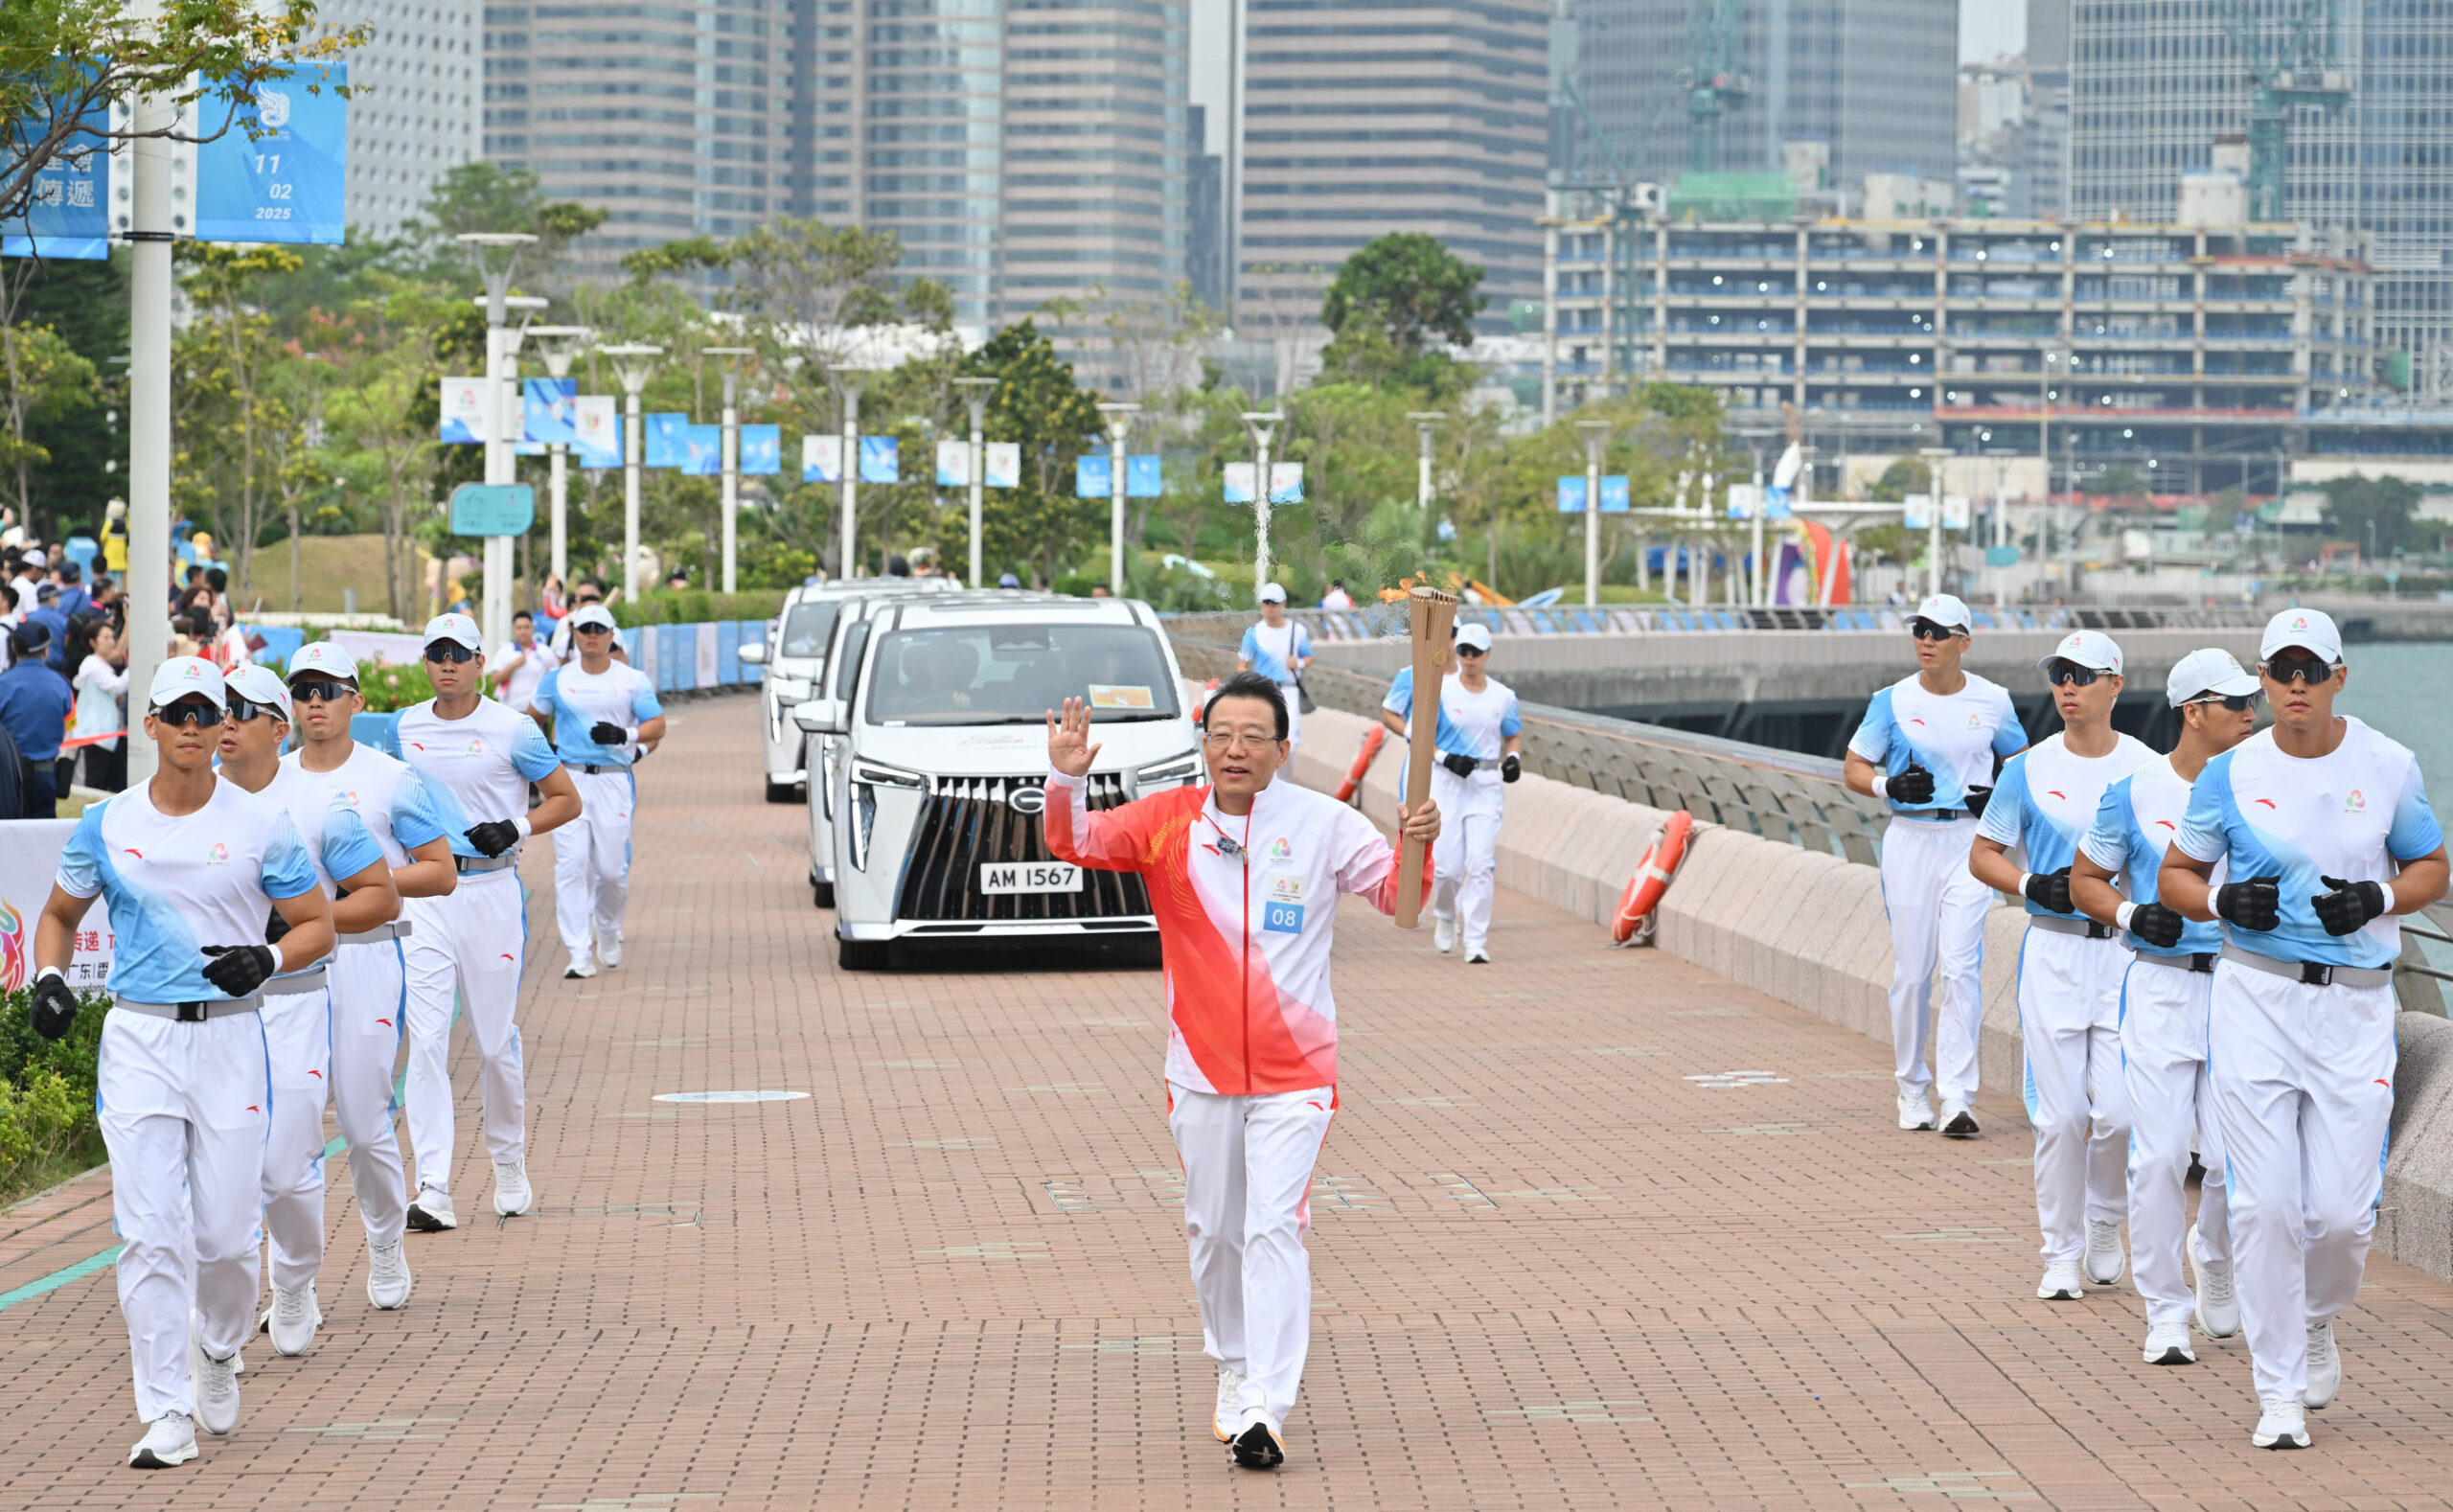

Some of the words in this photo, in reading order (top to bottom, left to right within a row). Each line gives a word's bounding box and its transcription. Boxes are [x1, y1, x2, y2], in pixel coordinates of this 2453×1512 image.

[255, 154, 280, 173] 11
[269, 183, 292, 199] 02
[255, 207, 291, 219] 2025
[989, 870, 1016, 887] AM
[1027, 868, 1075, 886] 1567
[1272, 909, 1295, 927] 08
